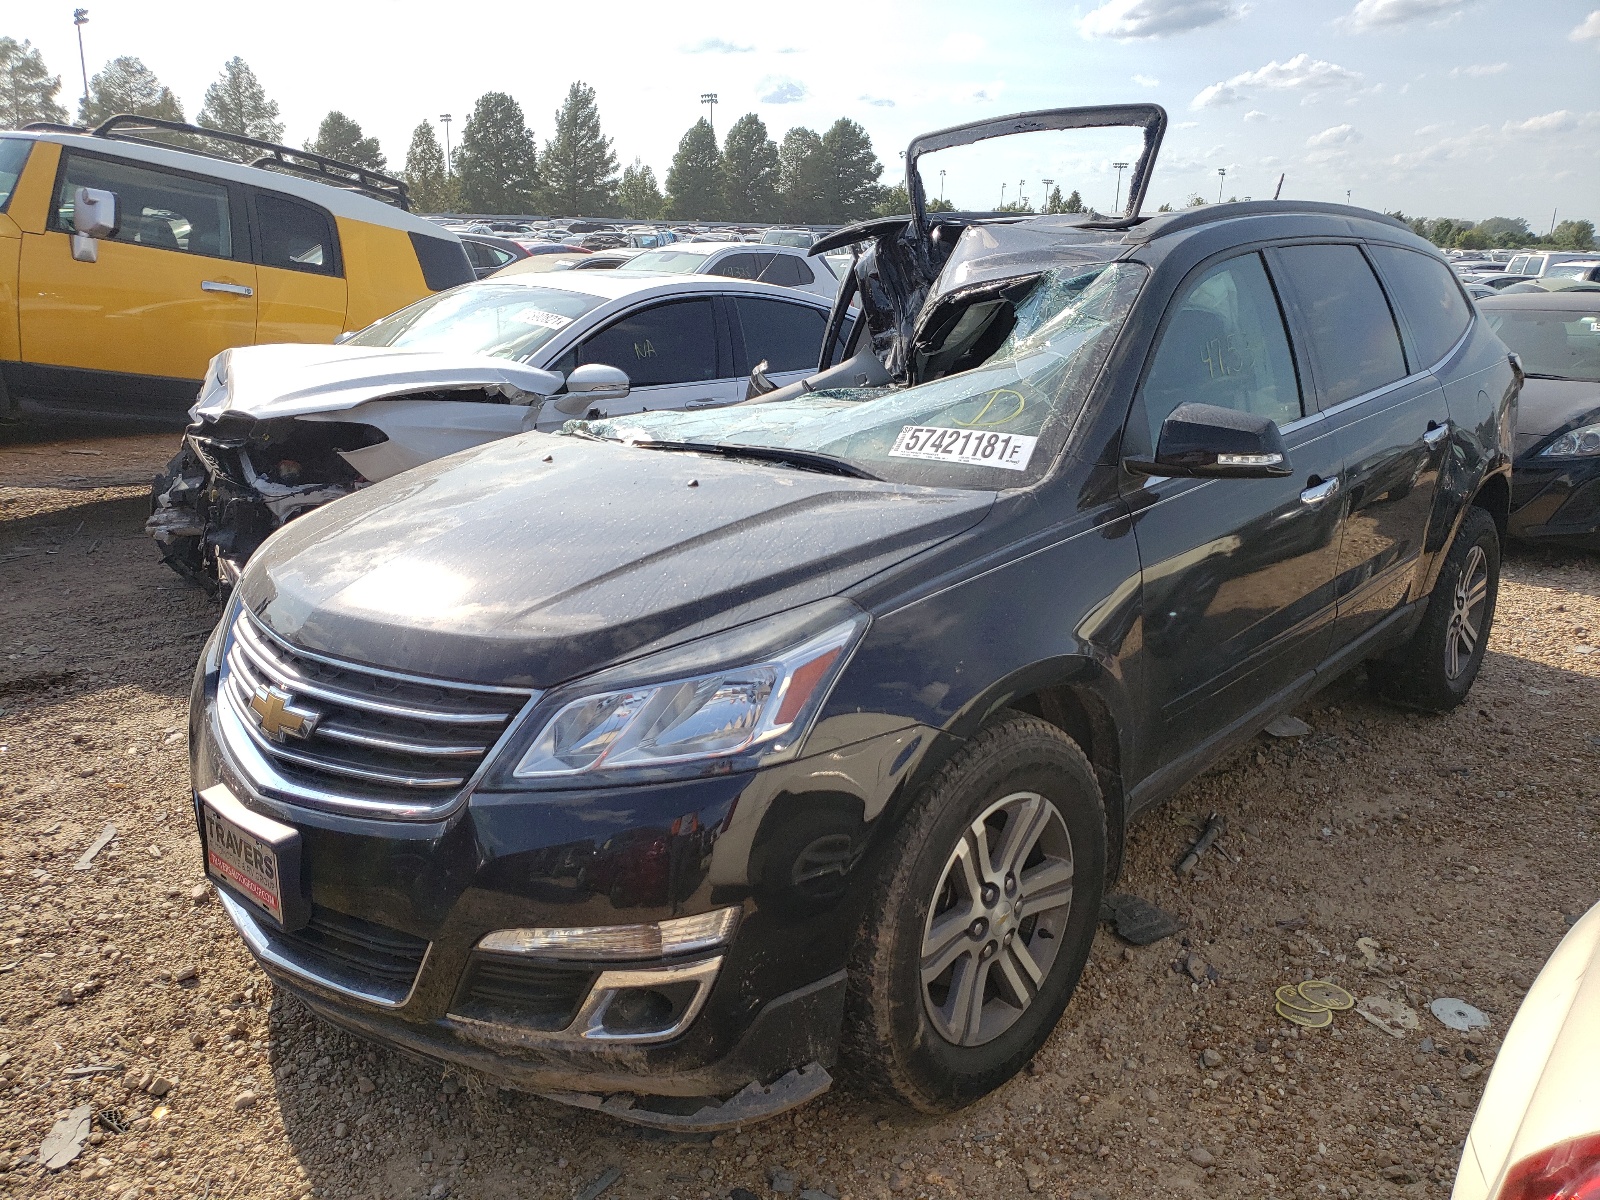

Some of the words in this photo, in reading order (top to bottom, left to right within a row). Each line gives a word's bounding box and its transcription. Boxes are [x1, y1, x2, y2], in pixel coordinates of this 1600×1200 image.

[634, 339, 657, 360] NA
[951, 389, 1025, 426] D
[904, 428, 1012, 460] 57421181
[1008, 445, 1021, 459] F
[205, 815, 275, 880] TRAVERS
[256, 872, 275, 891] GROUP
